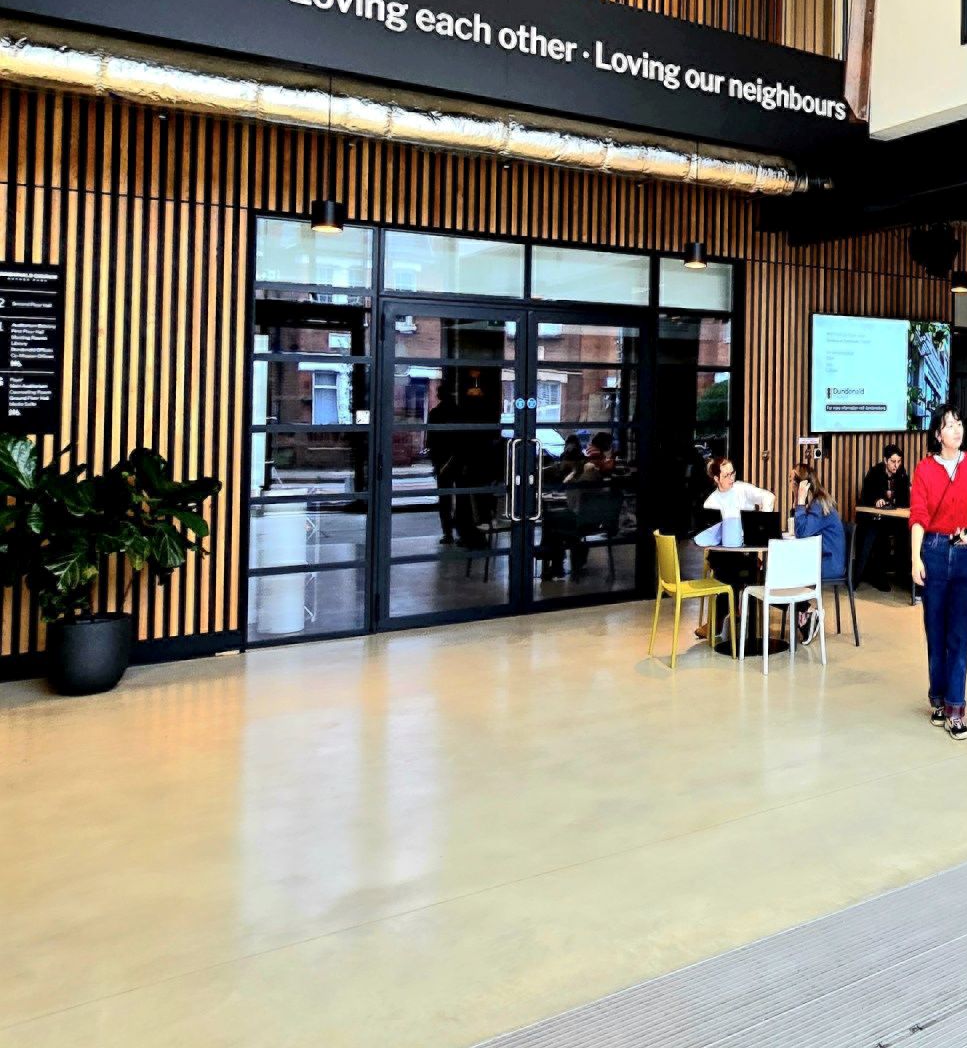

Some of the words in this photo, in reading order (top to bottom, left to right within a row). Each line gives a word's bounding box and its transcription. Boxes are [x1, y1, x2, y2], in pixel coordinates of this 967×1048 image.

[415, 12, 492, 45] each
[498, 24, 578, 62] other
[595, 40, 681, 90] Loving
[684, 68, 726, 94] our
[728, 75, 847, 121] neighbours
